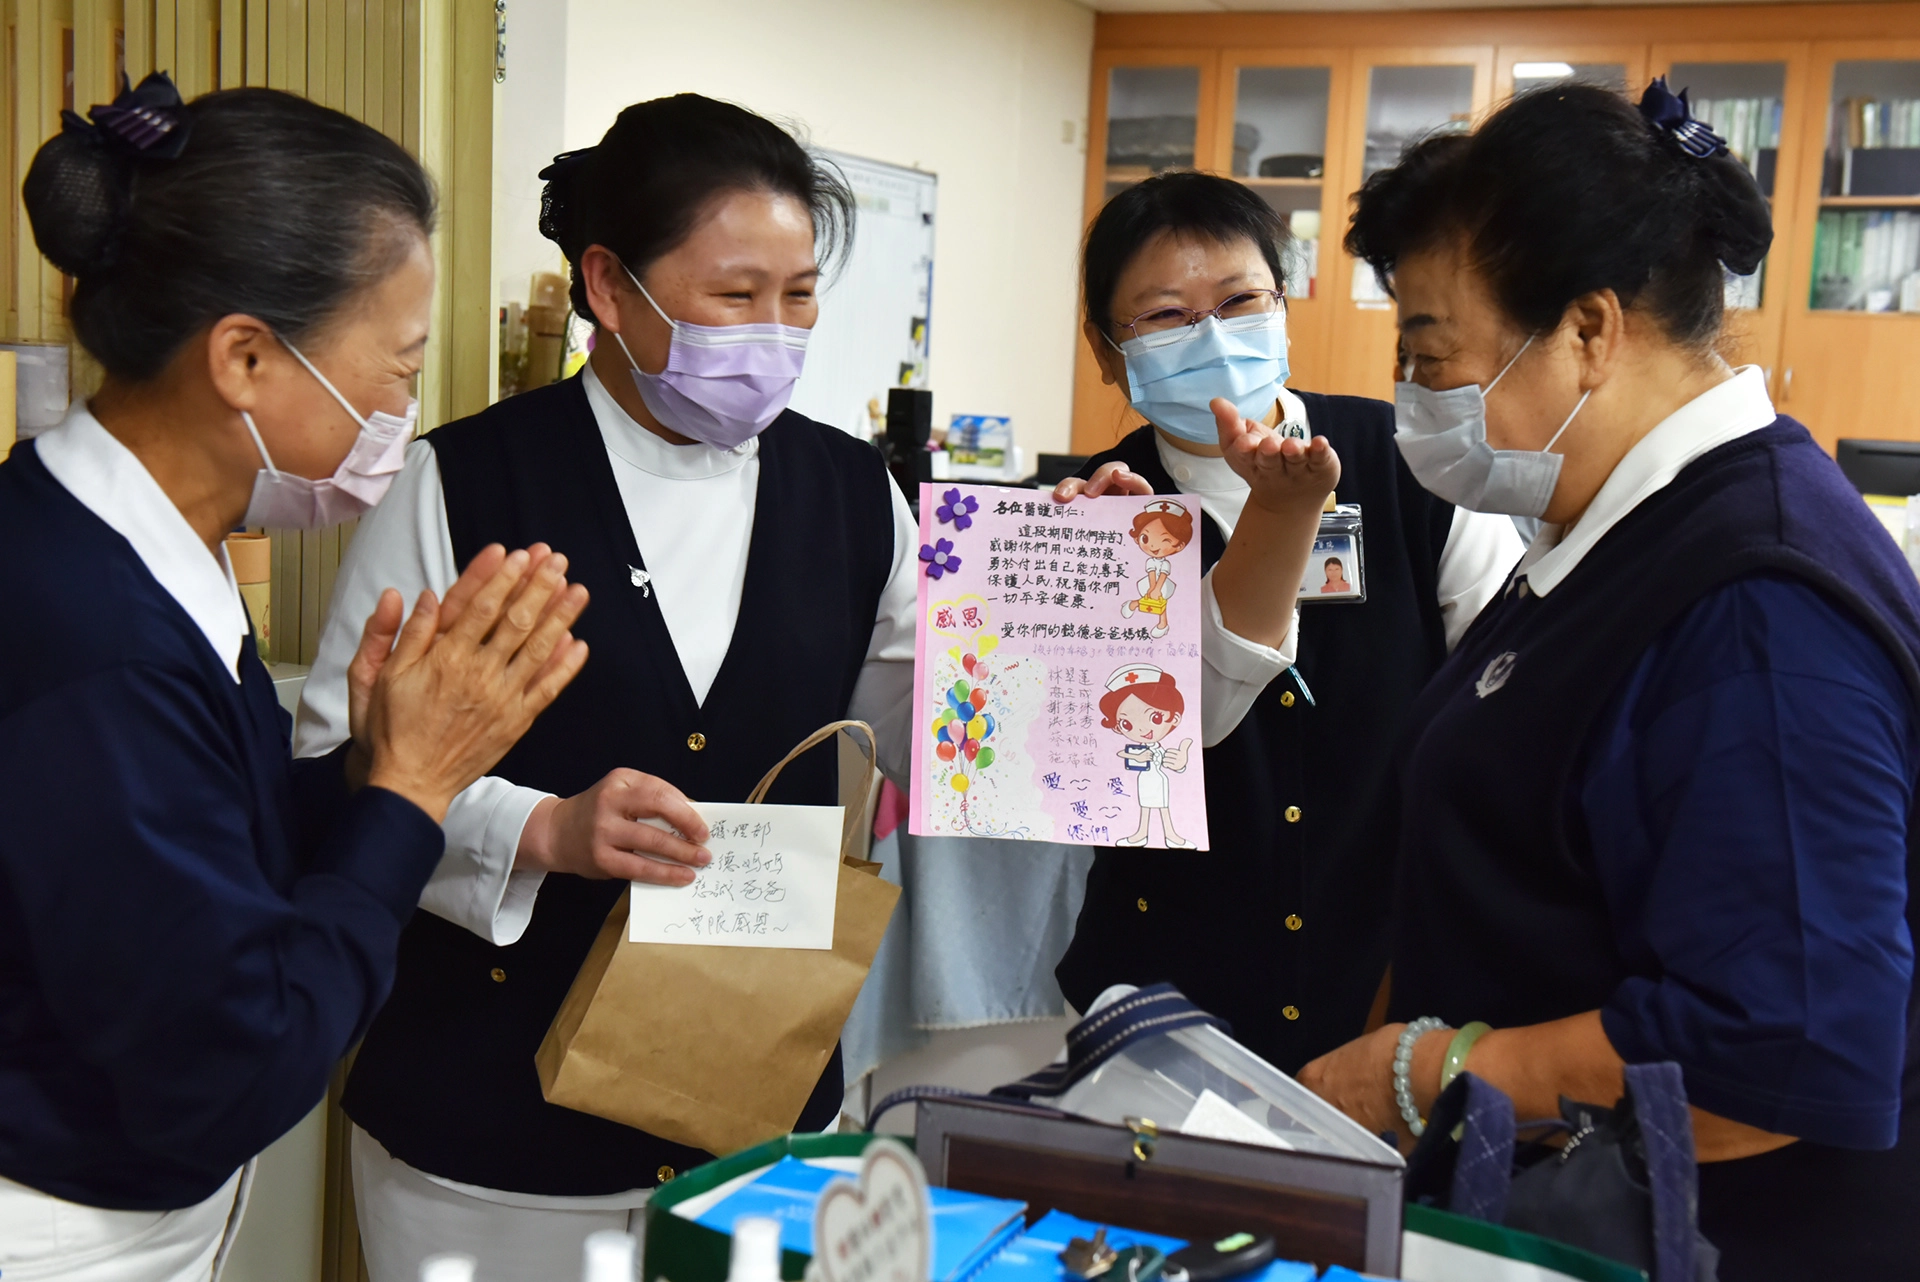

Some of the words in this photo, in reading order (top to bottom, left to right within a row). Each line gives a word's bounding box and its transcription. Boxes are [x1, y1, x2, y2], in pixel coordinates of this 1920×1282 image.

[935, 606, 983, 629] 感恩
[700, 851, 784, 875] 德媽媽
